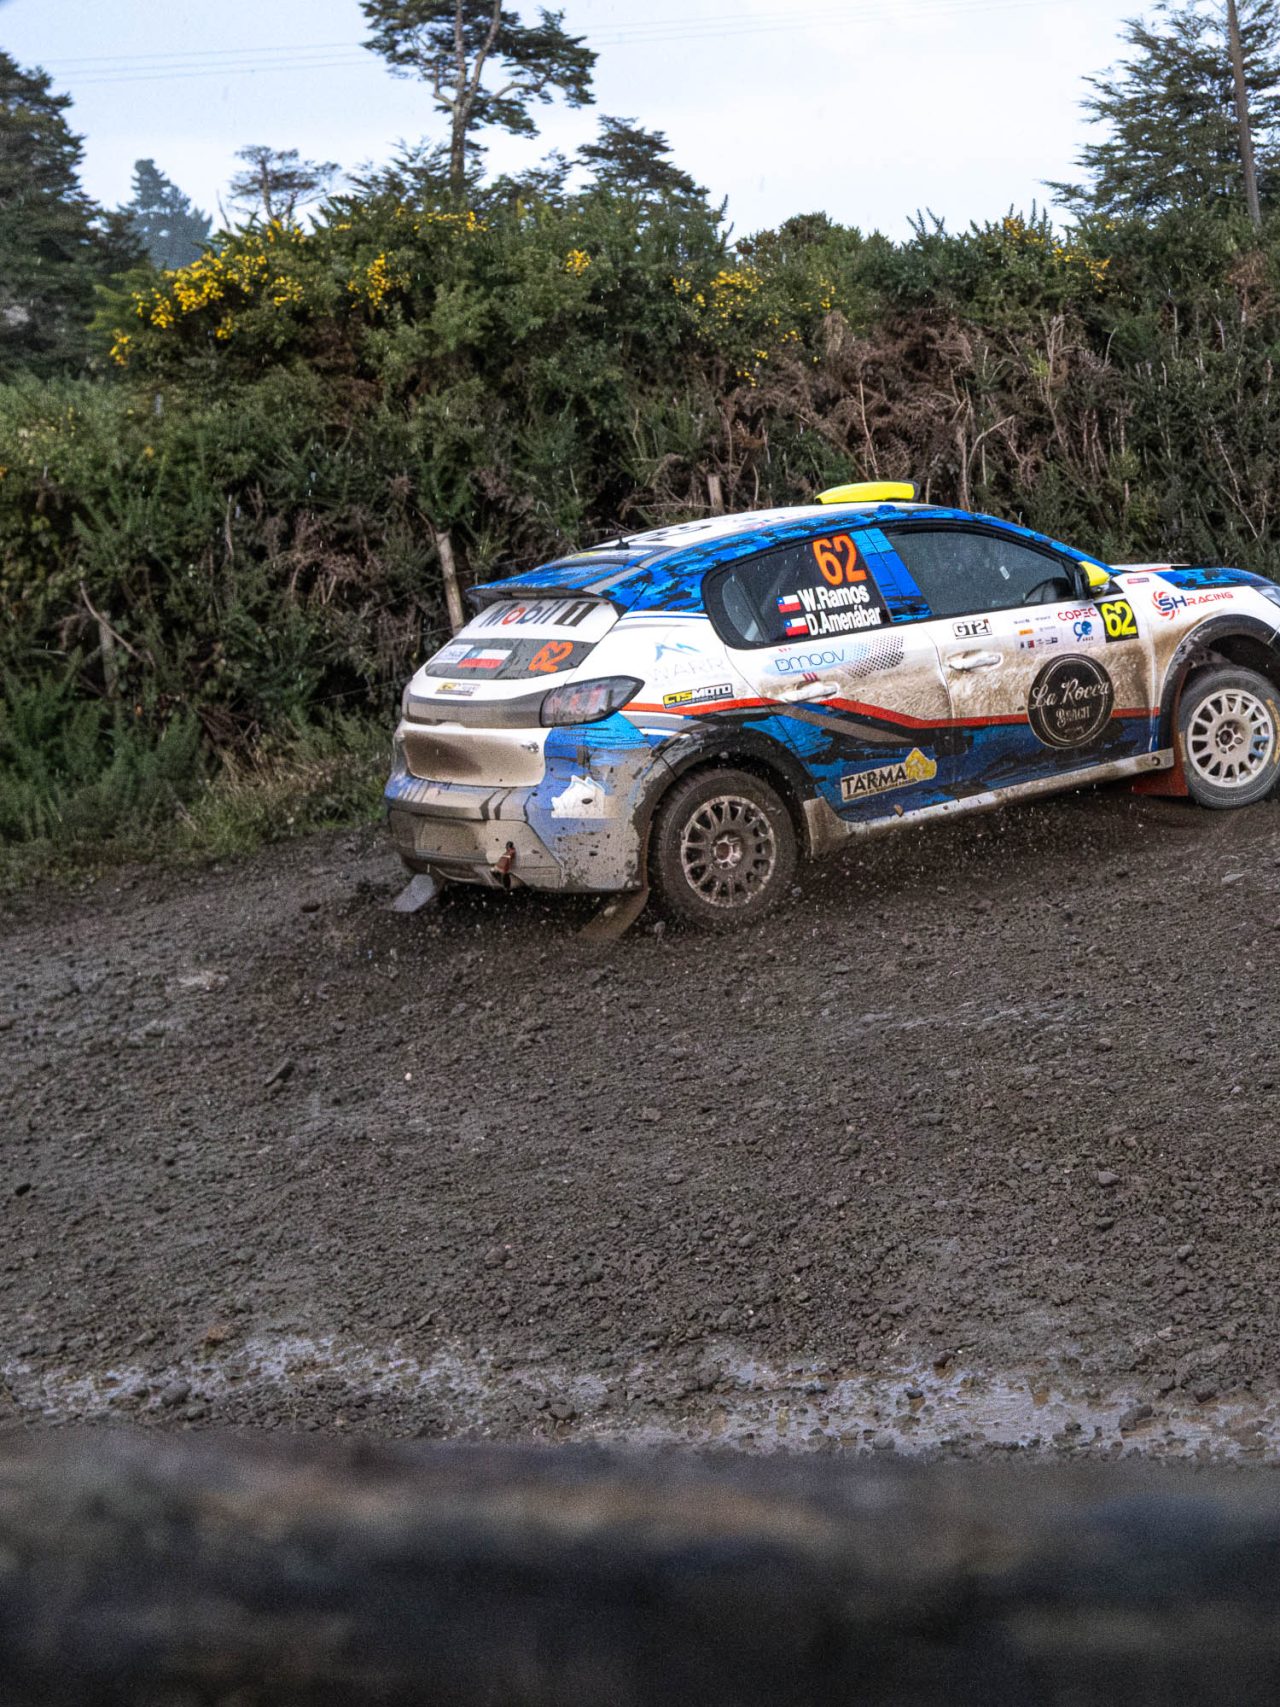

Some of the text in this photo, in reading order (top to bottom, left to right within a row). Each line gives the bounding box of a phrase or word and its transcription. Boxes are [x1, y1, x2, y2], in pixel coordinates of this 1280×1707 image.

[812, 533, 868, 586] 62
[797, 585, 870, 612] W.Ramos
[478, 601, 567, 628] Mobil
[805, 605, 881, 636] D.Amenábar
[1057, 607, 1098, 622] COPEC
[1101, 600, 1138, 639] 62
[528, 640, 574, 673] 62
[1029, 683, 1058, 710] La
[842, 765, 907, 795] TARMA
